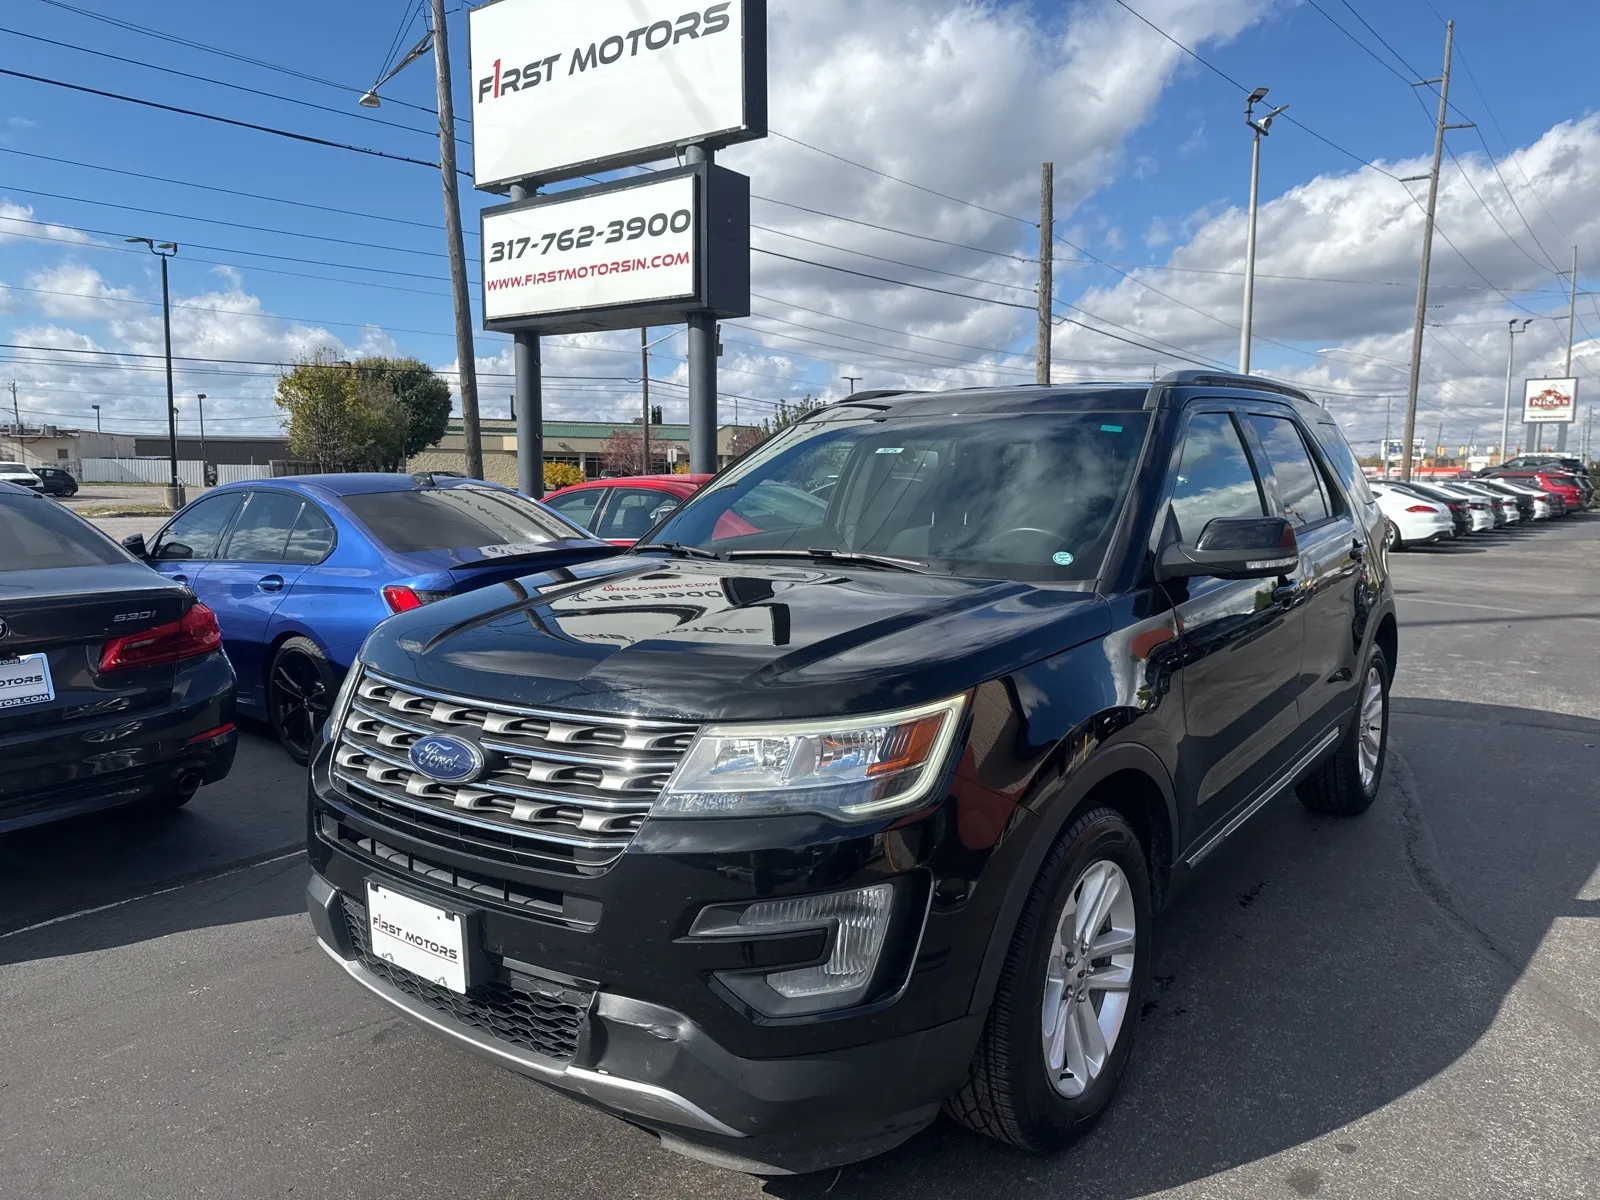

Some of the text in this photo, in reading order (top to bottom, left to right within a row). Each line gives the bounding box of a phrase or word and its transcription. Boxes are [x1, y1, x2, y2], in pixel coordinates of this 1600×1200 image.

[568, 1, 731, 76] MOTORS
[489, 209, 692, 263] 317-762-3900
[487, 251, 690, 291] WWW.FIRSTMOTORSIN.COM
[0, 674, 43, 686] OTORS
[0, 694, 49, 707] TOR.COM
[418, 741, 460, 771] Ford
[405, 931, 458, 960] MOTORS
